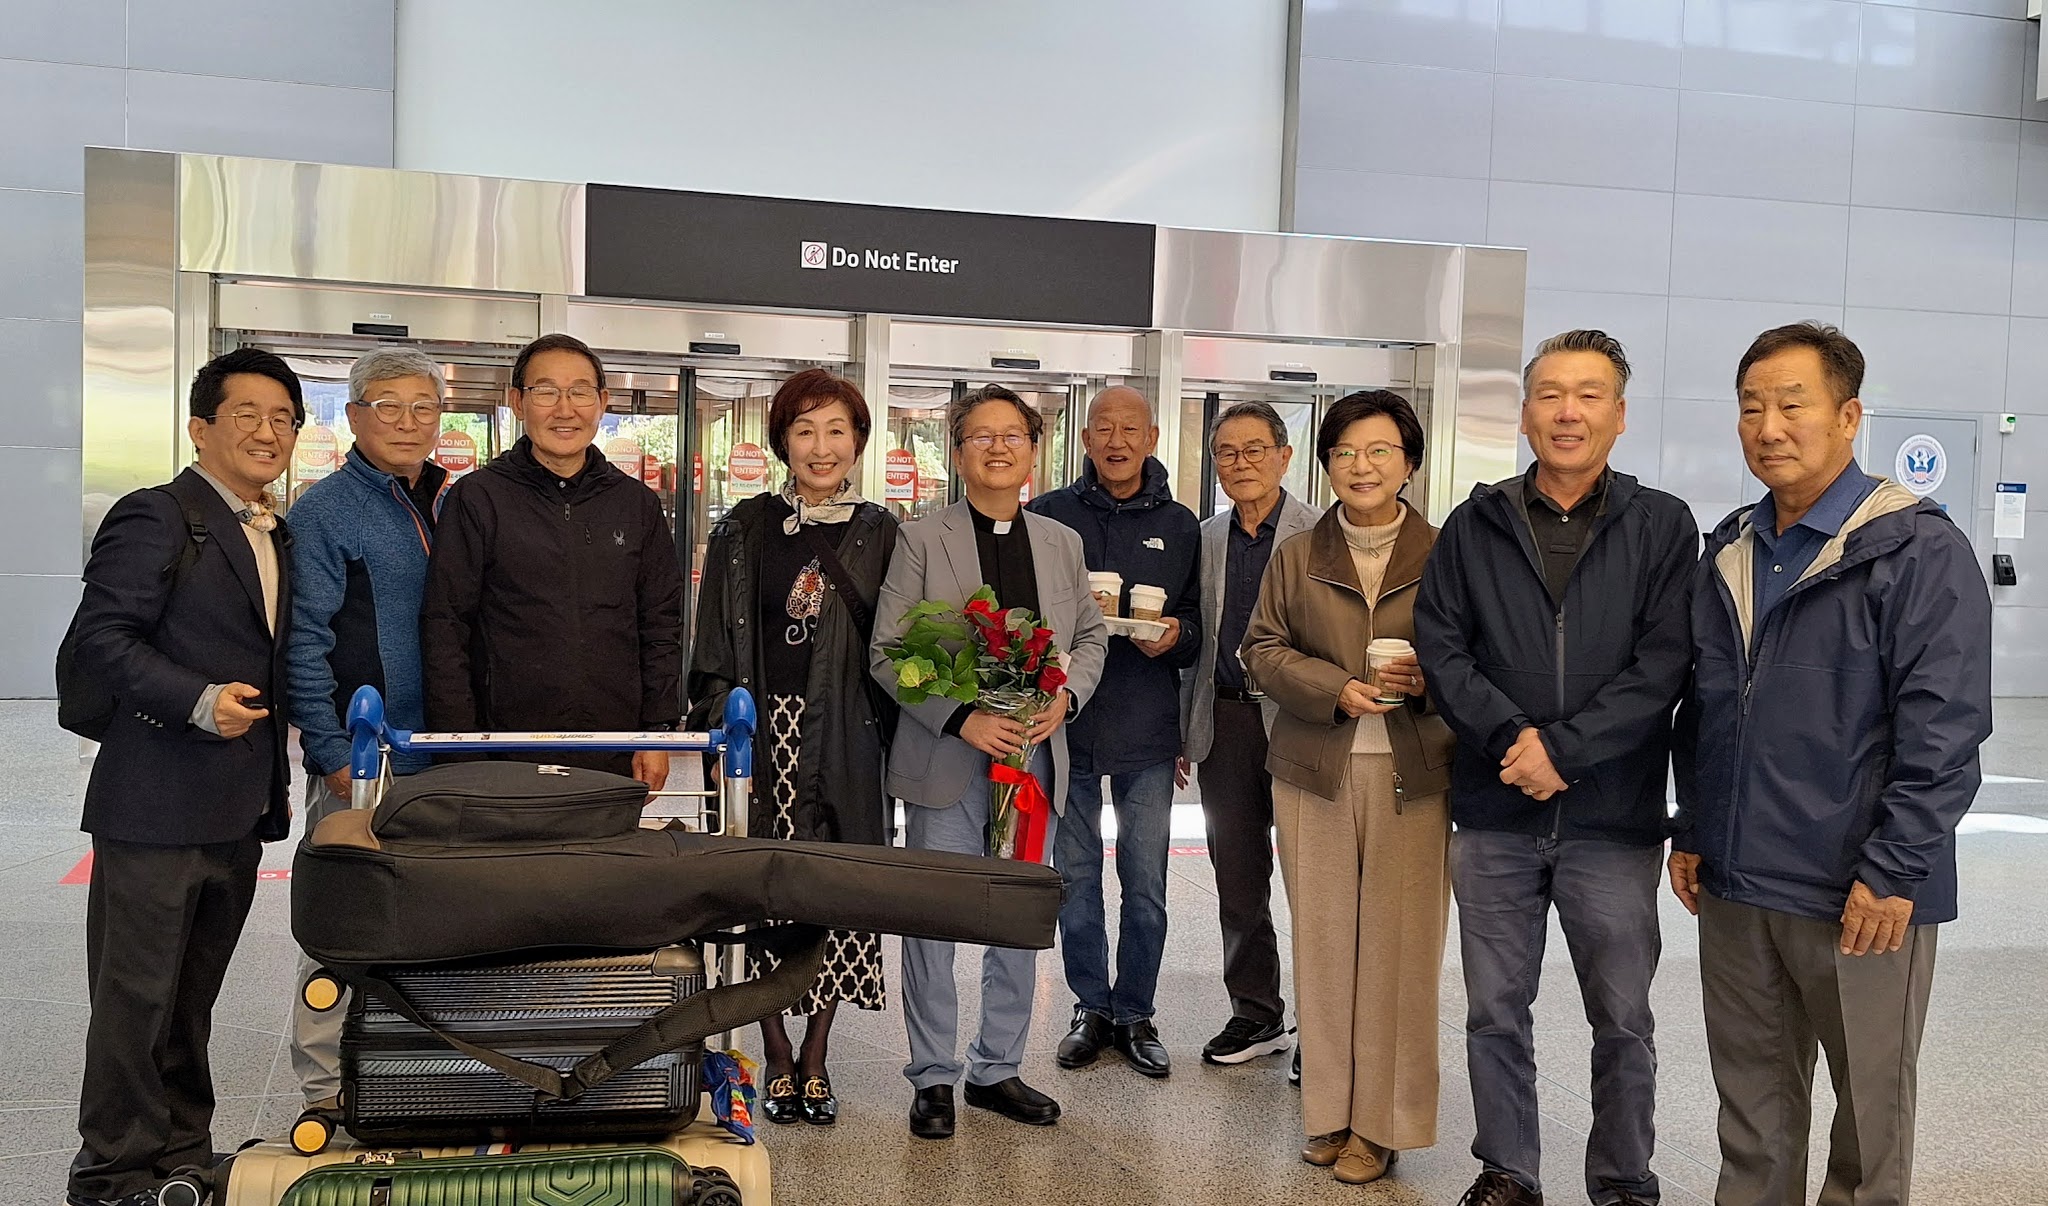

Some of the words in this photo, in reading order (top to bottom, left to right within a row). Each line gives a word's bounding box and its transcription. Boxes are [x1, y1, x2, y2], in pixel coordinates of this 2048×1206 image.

[832, 247, 859, 267] Do
[865, 250, 900, 270] Not
[906, 252, 959, 273] Enter
[440, 438, 453, 447] DO
[453, 439, 471, 447] NOT
[733, 450, 745, 458] DO
[745, 450, 761, 458] NOT
[897, 456, 912, 464] NOT
[734, 466, 762, 475] ENTER
[886, 472, 910, 480] ENTER
